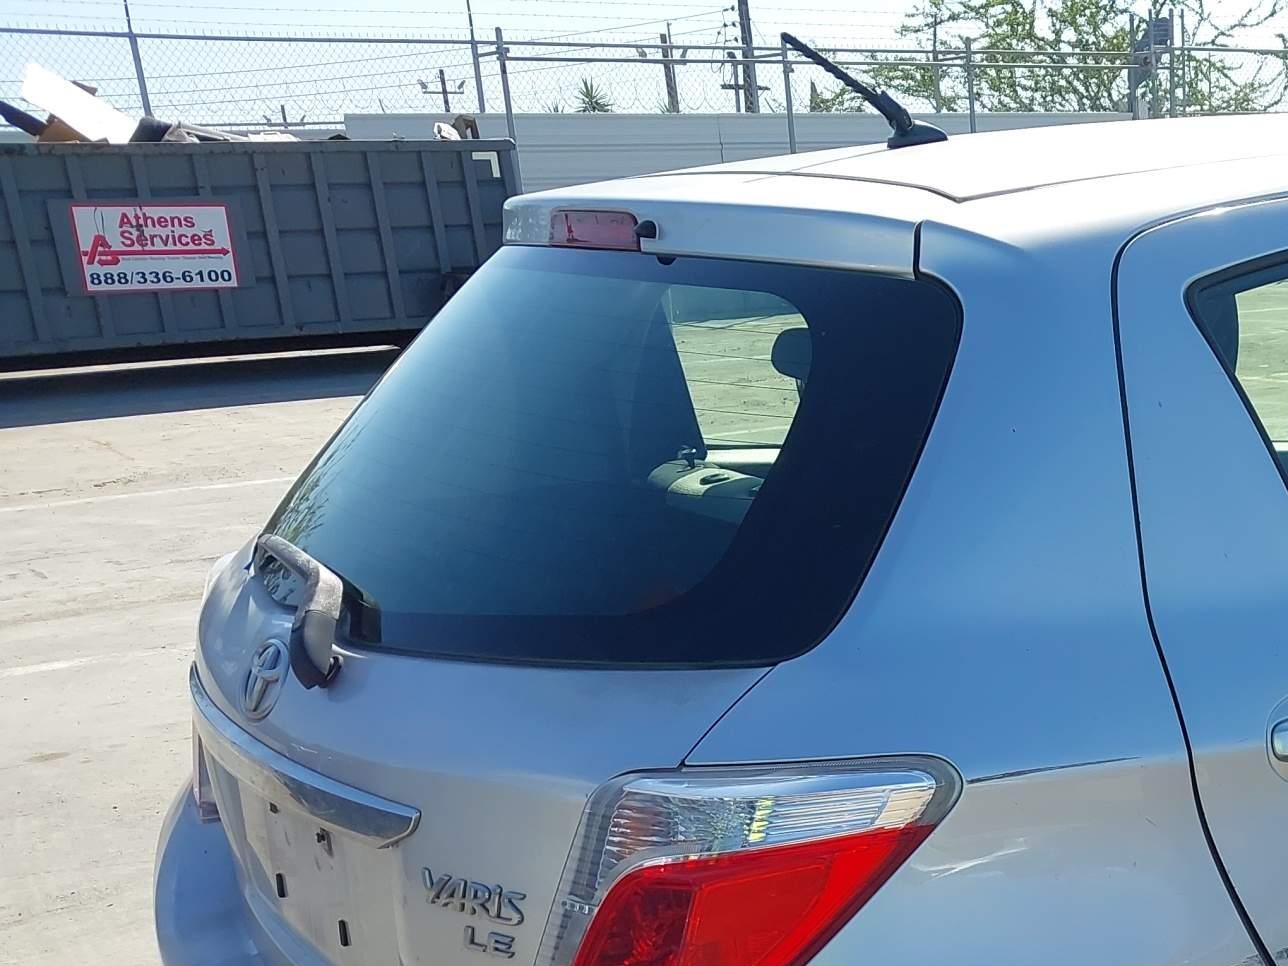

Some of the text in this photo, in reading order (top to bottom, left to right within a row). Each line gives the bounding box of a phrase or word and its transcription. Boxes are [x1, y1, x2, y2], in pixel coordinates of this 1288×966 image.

[118, 212, 196, 229] Athens
[120, 230, 216, 248] Services
[89, 269, 233, 286] 888/336-6100
[422, 867, 527, 926] YARIS
[464, 925, 515, 959] LE
